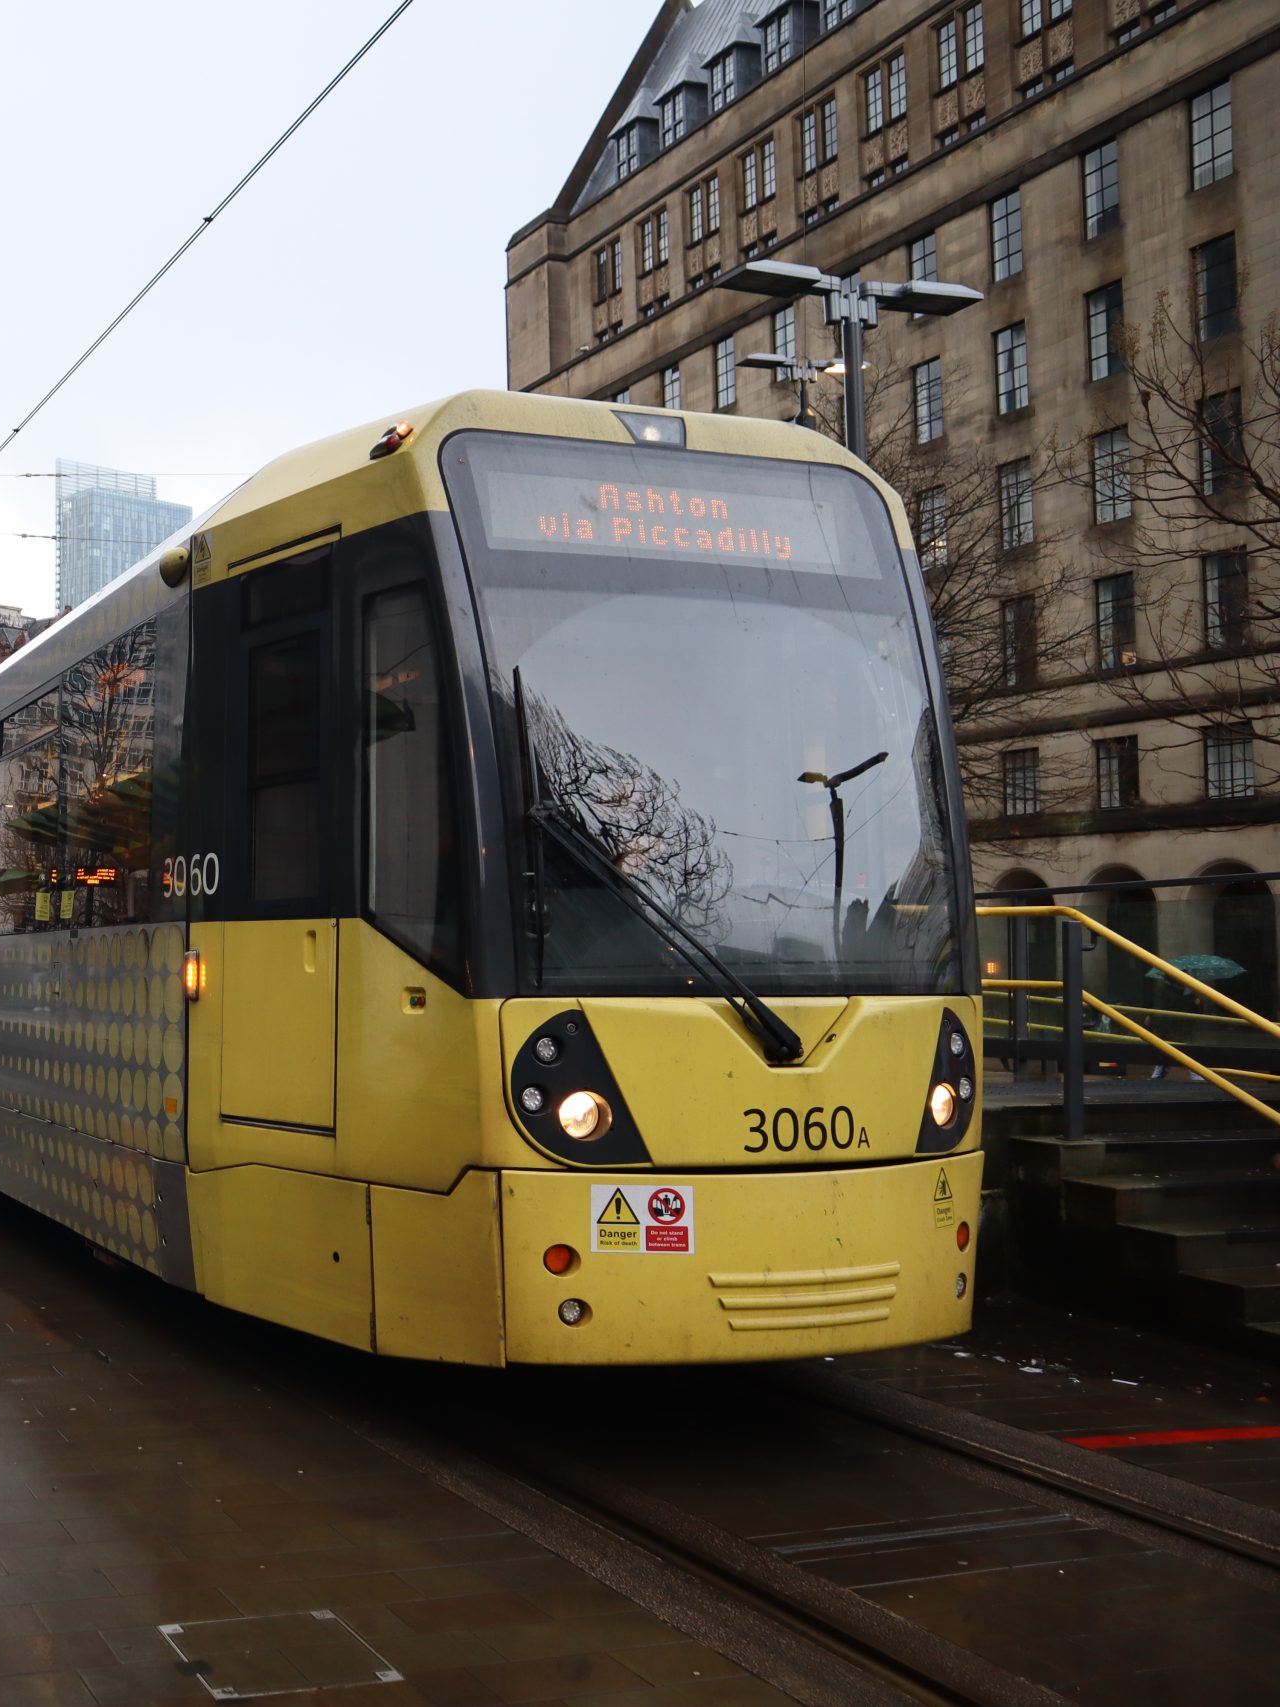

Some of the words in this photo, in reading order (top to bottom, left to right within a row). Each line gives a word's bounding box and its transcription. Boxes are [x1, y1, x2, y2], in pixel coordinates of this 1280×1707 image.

[599, 483, 729, 520] Ashton
[538, 511, 593, 540] via
[611, 516, 793, 560] Piccadilly
[163, 852, 220, 898] 3060
[743, 1105, 871, 1153] 3060A
[599, 1229, 638, 1240] Danger
